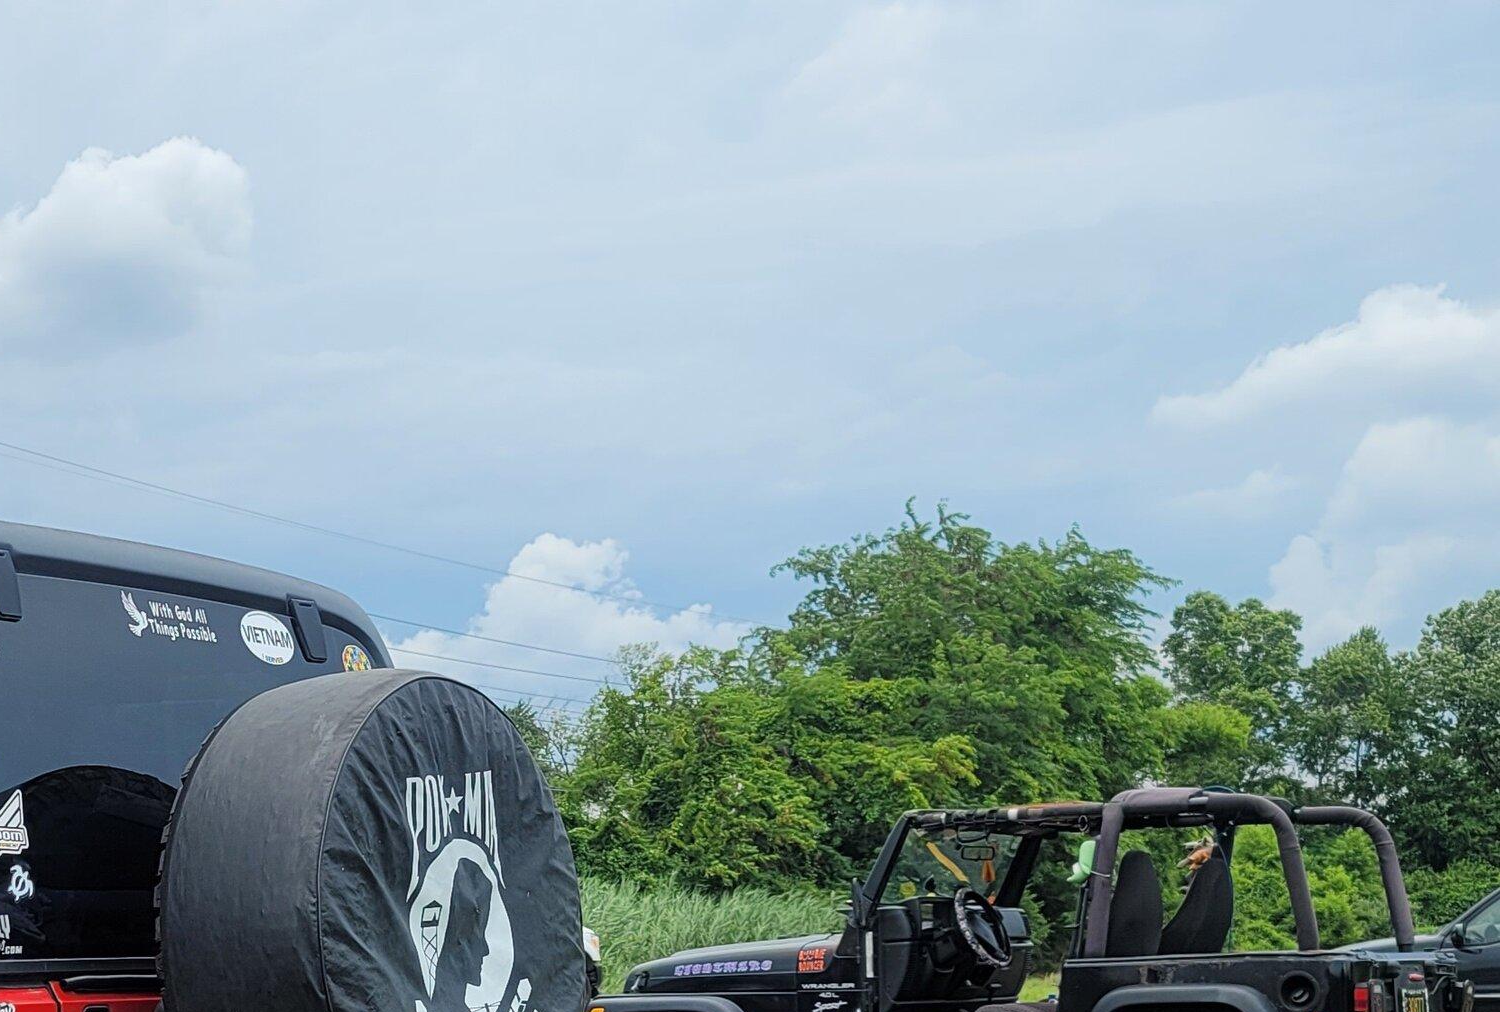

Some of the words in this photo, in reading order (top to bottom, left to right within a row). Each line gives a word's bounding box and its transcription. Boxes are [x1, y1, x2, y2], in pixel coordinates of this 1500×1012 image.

[149, 601, 174, 617] With
[175, 604, 193, 622] God
[195, 608, 207, 624] All
[149, 618, 180, 641] Things
[181, 622, 218, 643] Possible
[242, 624, 293, 649] VIETNAM
[405, 774, 451, 903] POW
[464, 769, 506, 890] MIA
[802, 982, 855, 990] WRANGLER
